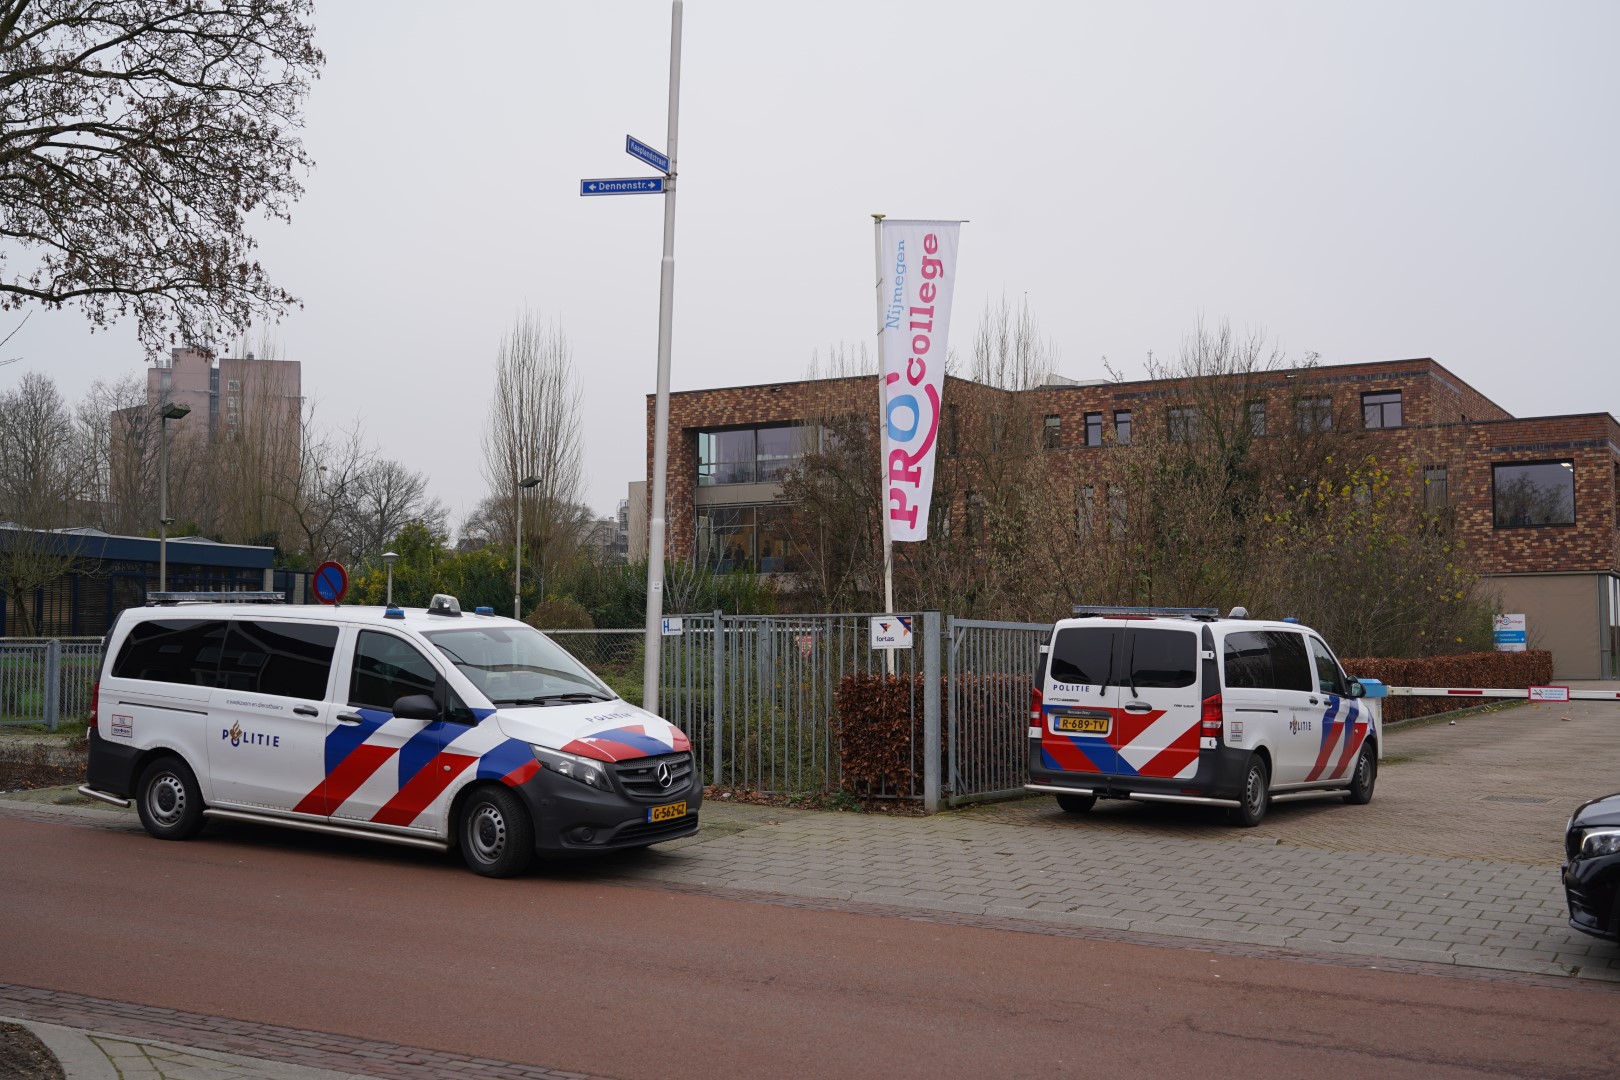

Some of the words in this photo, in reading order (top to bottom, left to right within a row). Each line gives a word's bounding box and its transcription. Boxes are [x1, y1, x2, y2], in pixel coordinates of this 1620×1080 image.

[598, 182, 647, 191] Dennenstr.
[885, 239, 907, 330] Nijmegen
[1053, 684, 1090, 692] POLITIE
[1062, 719, 1105, 730] R-689-TV
[1289, 721, 1311, 735] POLITIE
[222, 729, 280, 747] POLITIE
[654, 803, 685, 819] G-562-GZ
